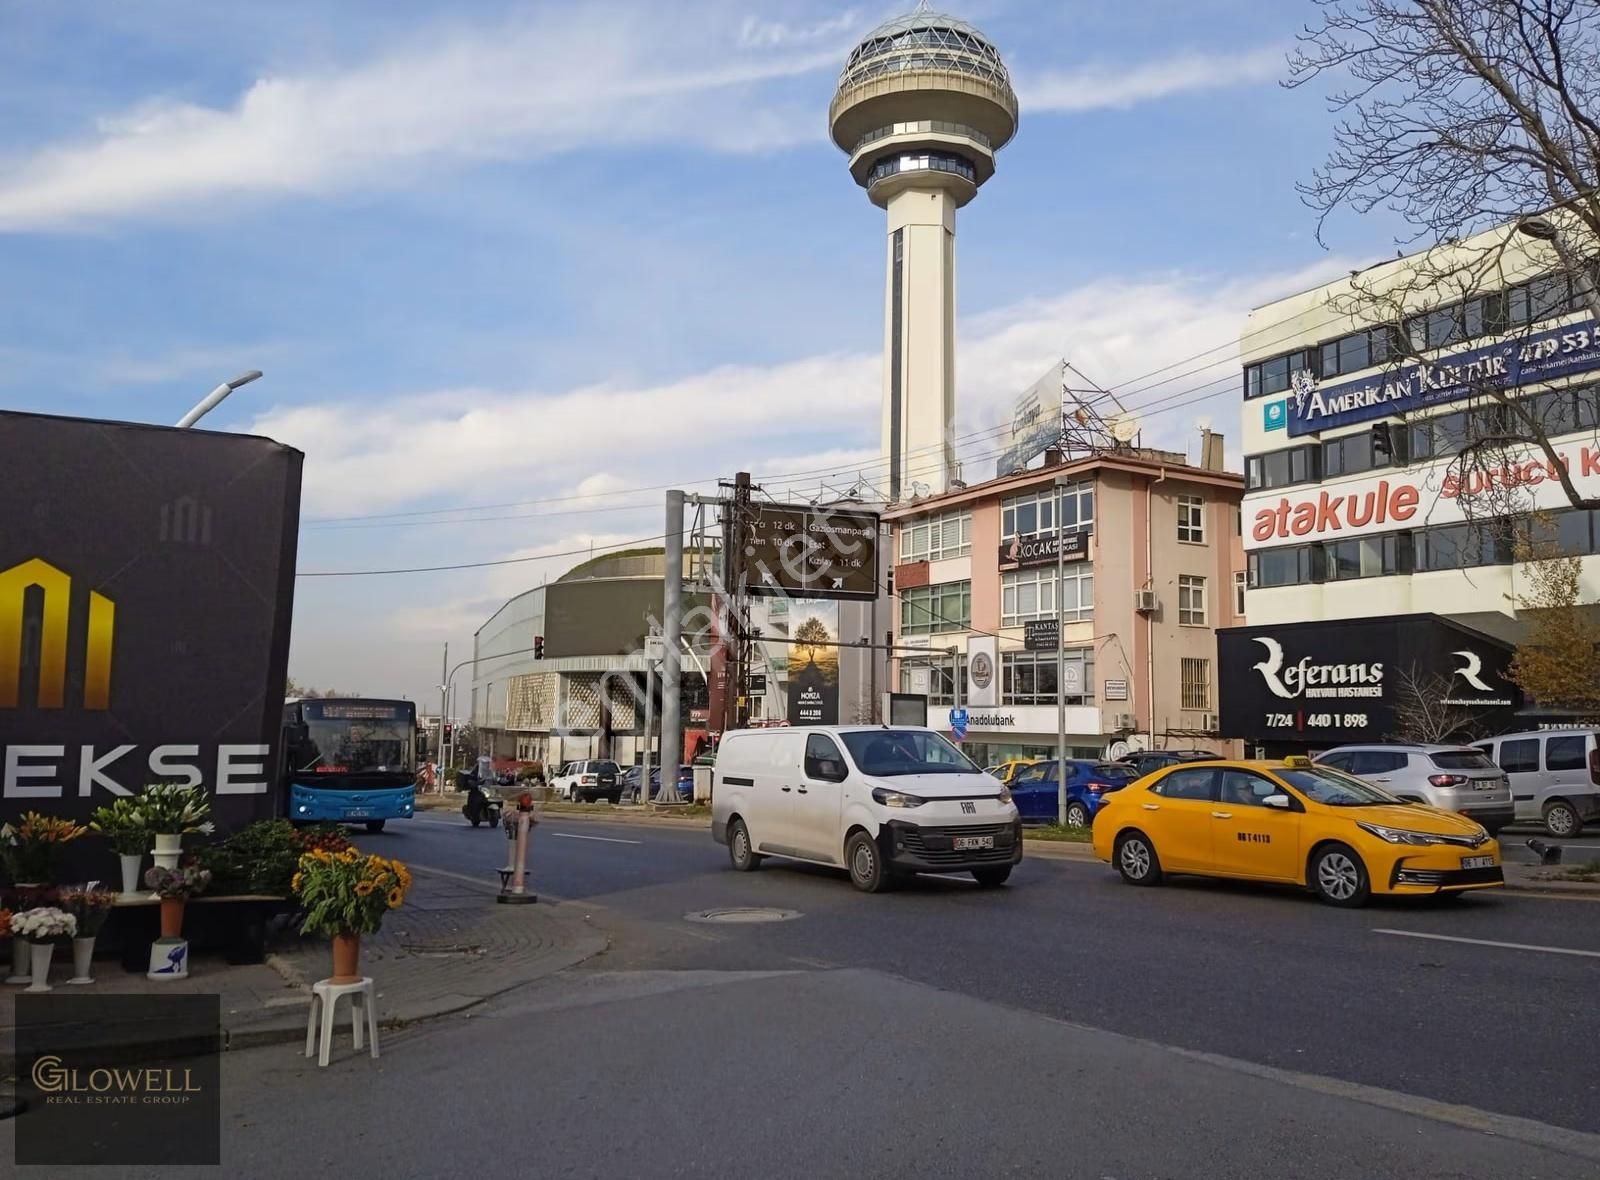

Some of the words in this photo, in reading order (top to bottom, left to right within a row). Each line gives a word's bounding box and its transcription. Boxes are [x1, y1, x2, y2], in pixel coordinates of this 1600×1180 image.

[1252, 480, 1420, 542] atakule
[1020, 541, 1052, 558] KOÇAK
[965, 713, 1016, 727] Anadolubank
[1265, 713, 1294, 727] 7/24
[1307, 713, 1331, 727] 440
[1343, 713, 1368, 727] 898
[960, 802, 976, 814] FIAT
